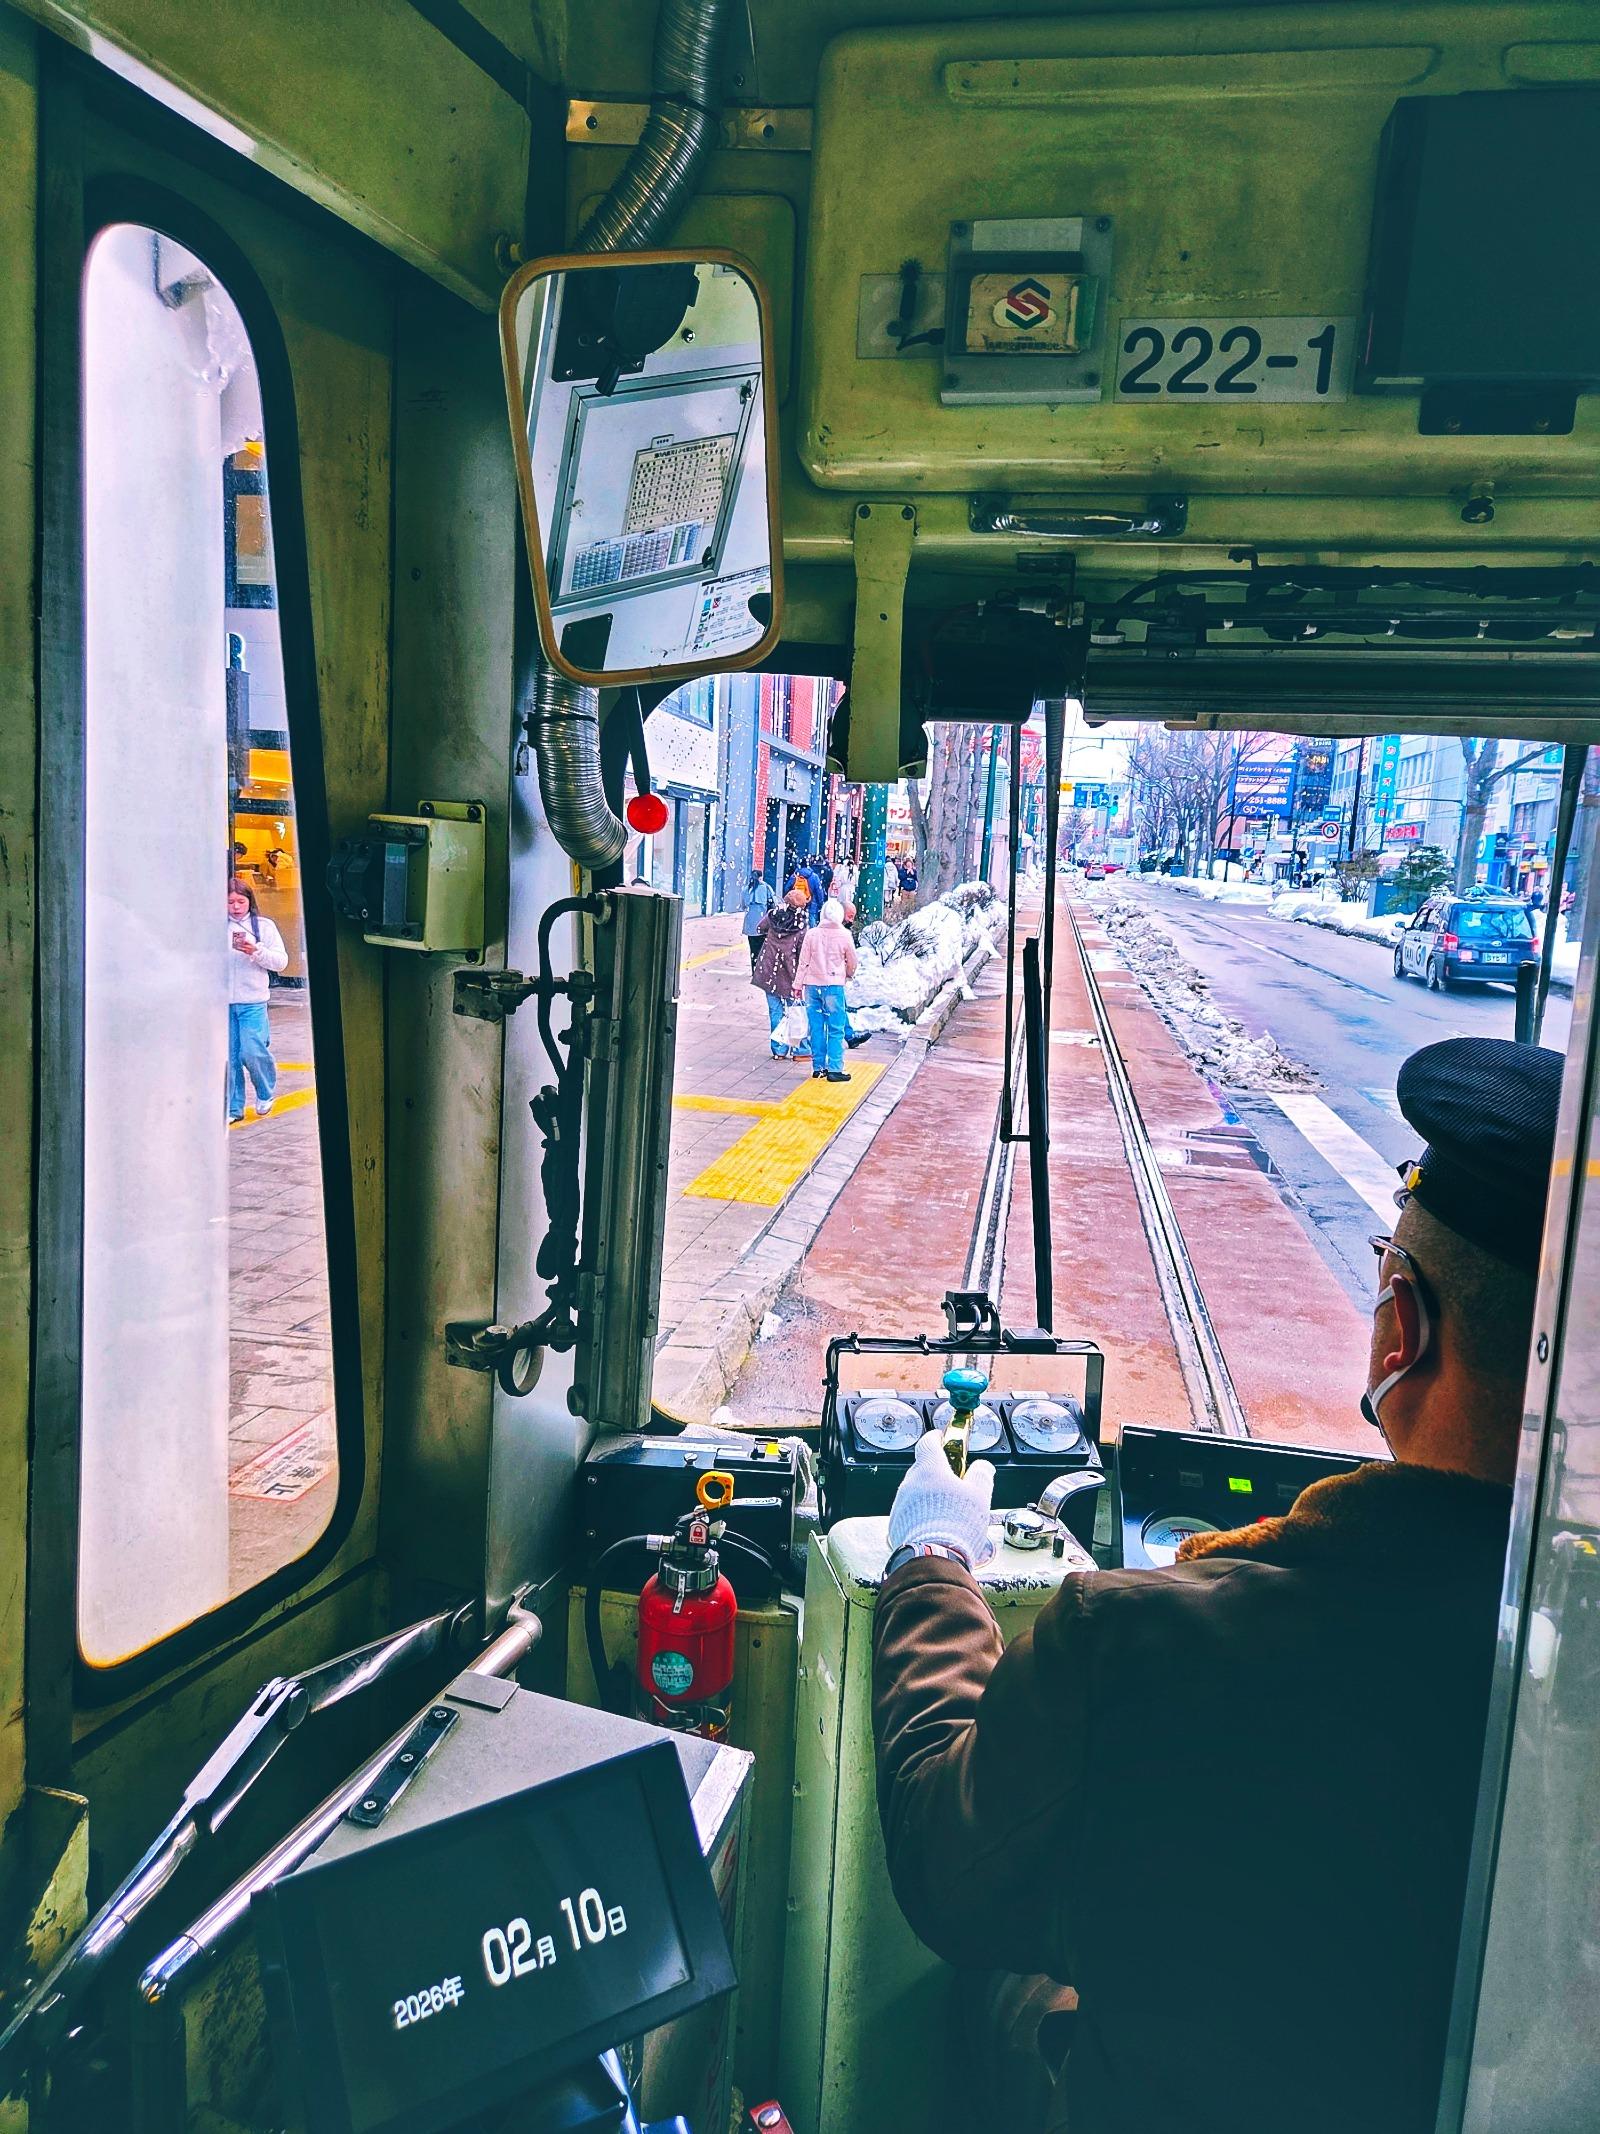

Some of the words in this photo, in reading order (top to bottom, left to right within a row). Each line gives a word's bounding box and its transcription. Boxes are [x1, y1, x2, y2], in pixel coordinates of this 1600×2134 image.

[1119, 324, 1336, 395] 222-1
[393, 1975, 465, 2029] 2026年
[482, 1917, 557, 1987] 02月
[560, 1887, 627, 1951] 10日
